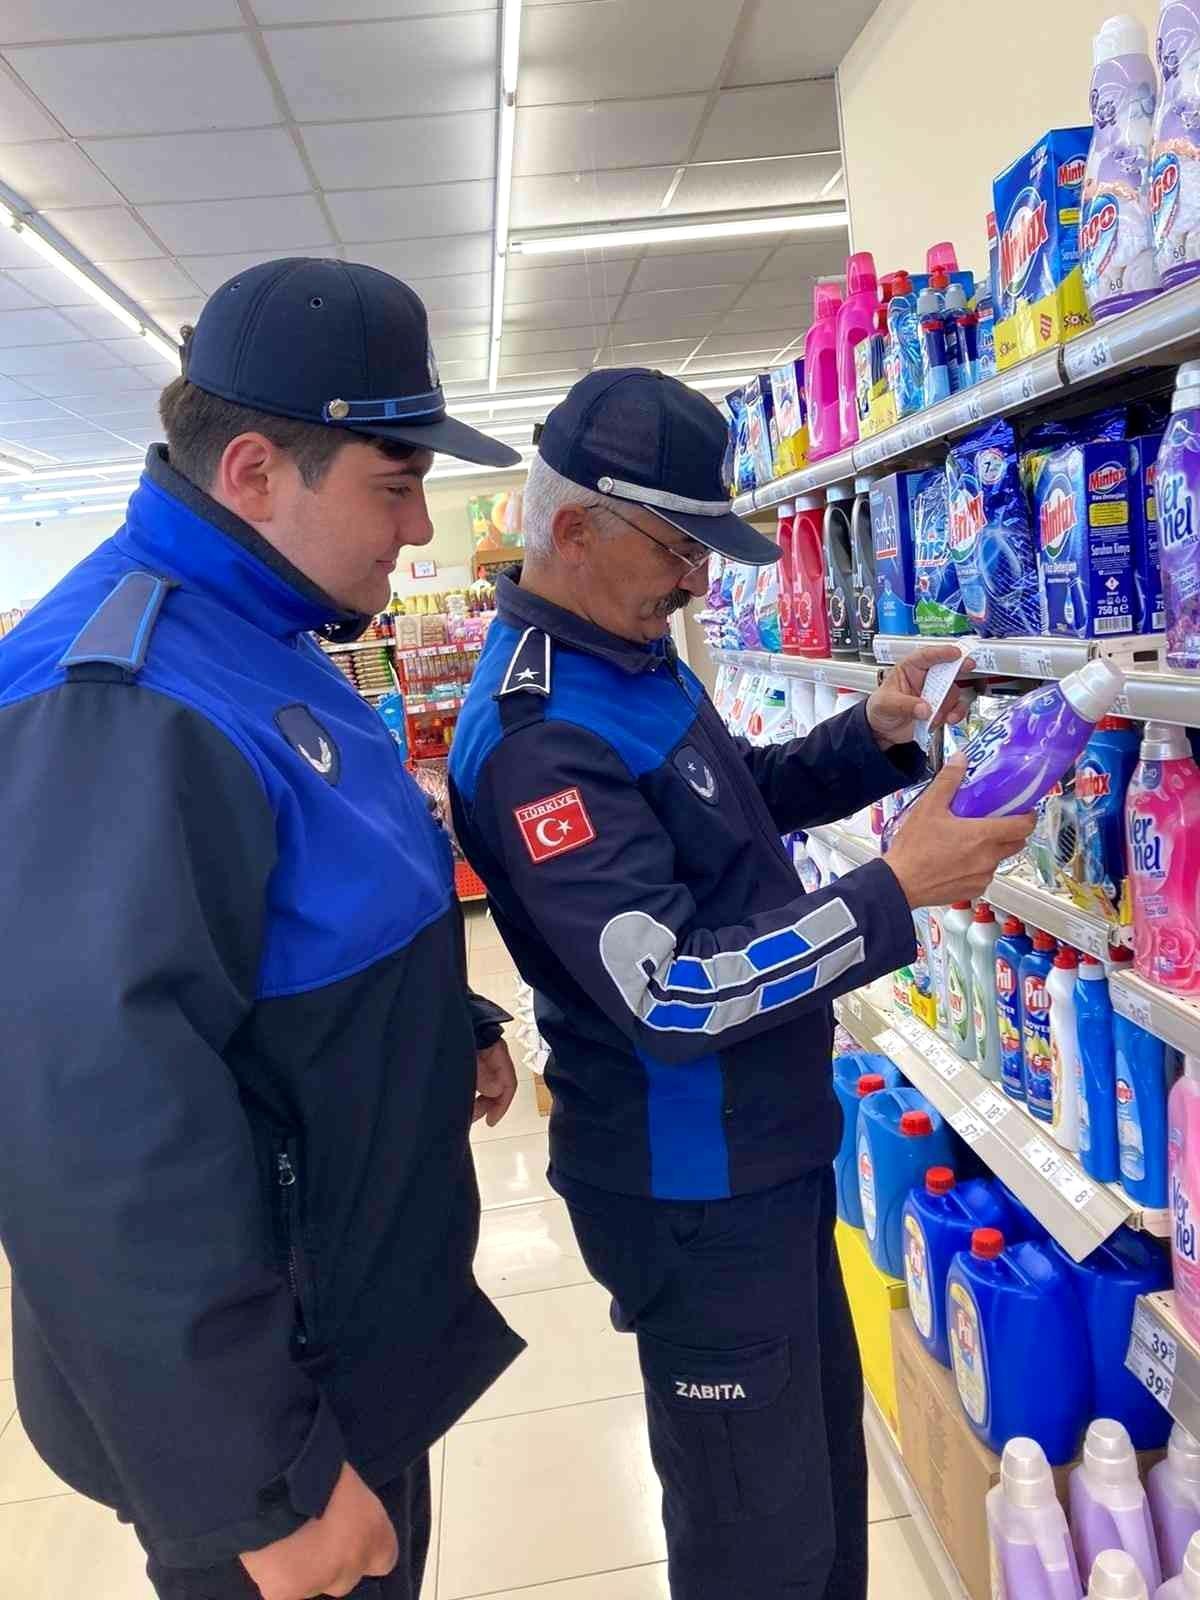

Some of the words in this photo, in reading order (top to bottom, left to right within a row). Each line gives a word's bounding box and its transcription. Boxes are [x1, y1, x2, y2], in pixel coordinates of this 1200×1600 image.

[1089, 467, 1127, 491] Mintax
[1163, 495, 1193, 547] nel
[1128, 809, 1152, 845] Ver
[1133, 835, 1160, 871] nel
[984, 1103, 1001, 1120] 18
[959, 1123, 978, 1137] 57
[1176, 1222, 1196, 1262] nel
[1151, 1332, 1168, 1360] 39
[675, 1381, 747, 1401] ZABITA
[1145, 1367, 1164, 1396] 39
